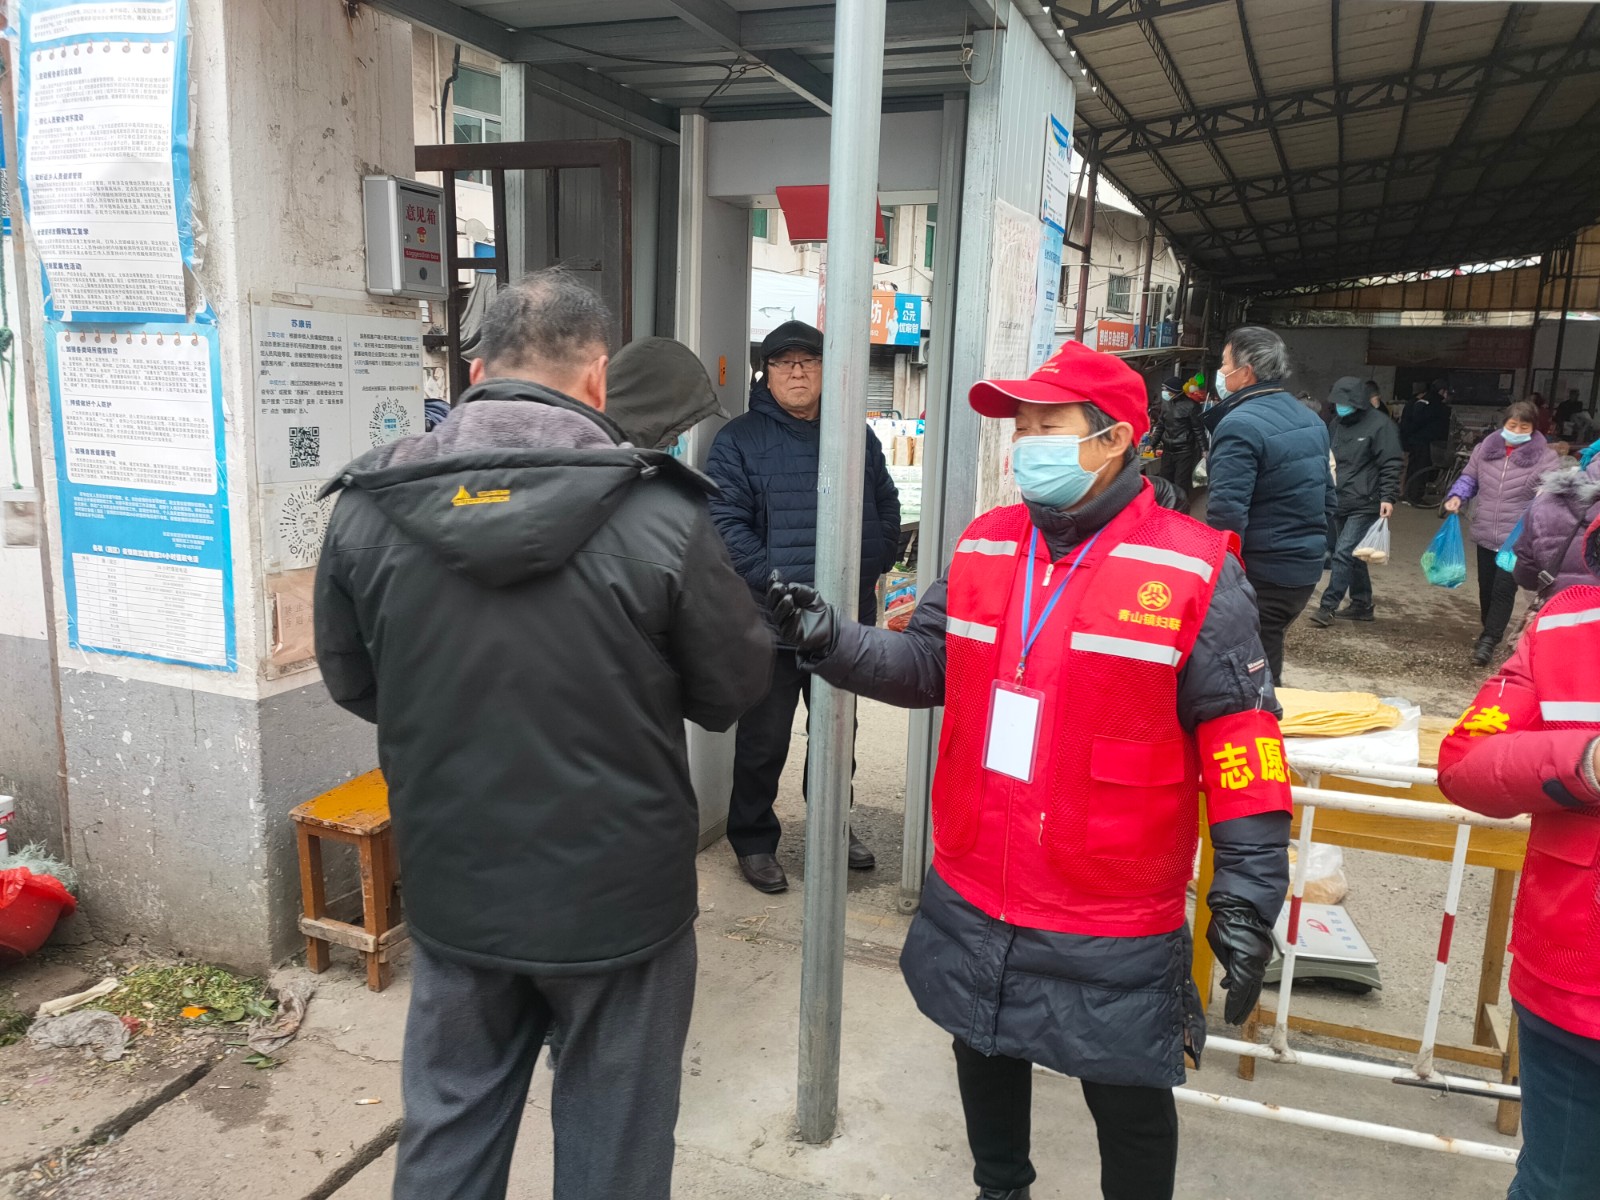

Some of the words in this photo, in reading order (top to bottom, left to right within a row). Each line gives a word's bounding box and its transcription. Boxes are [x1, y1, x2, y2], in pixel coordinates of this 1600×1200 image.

[406, 203, 436, 225] 意见箱
[291, 319, 312, 329] 苏康码
[902, 310, 916, 321] 公元
[1118, 609, 1182, 632] 青山镇妇联
[1212, 737, 1291, 790] 志愿
